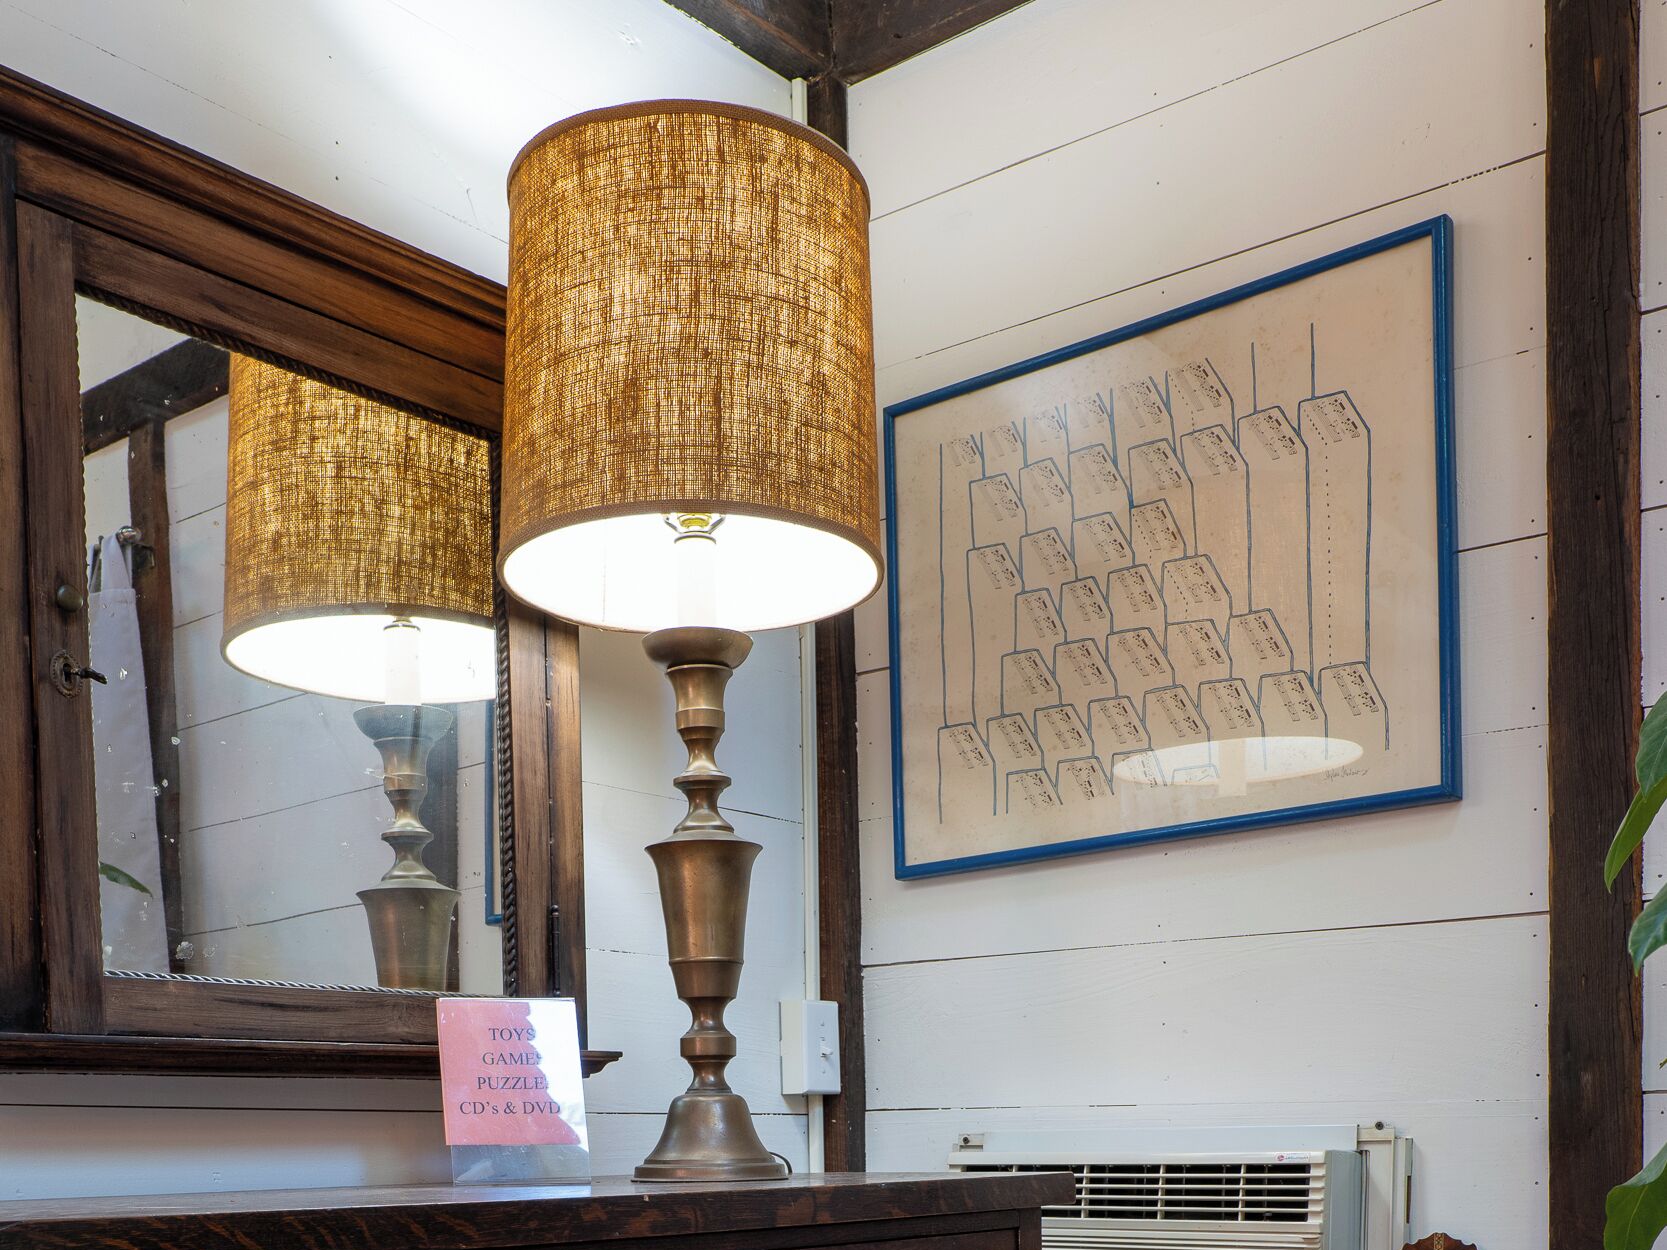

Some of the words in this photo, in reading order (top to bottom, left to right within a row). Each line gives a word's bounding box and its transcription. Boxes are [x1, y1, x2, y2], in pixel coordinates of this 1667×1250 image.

[488, 1027, 536, 1041] TOYS
[477, 1076, 549, 1090] PUZZLE
[503, 1101, 518, 1115] &
